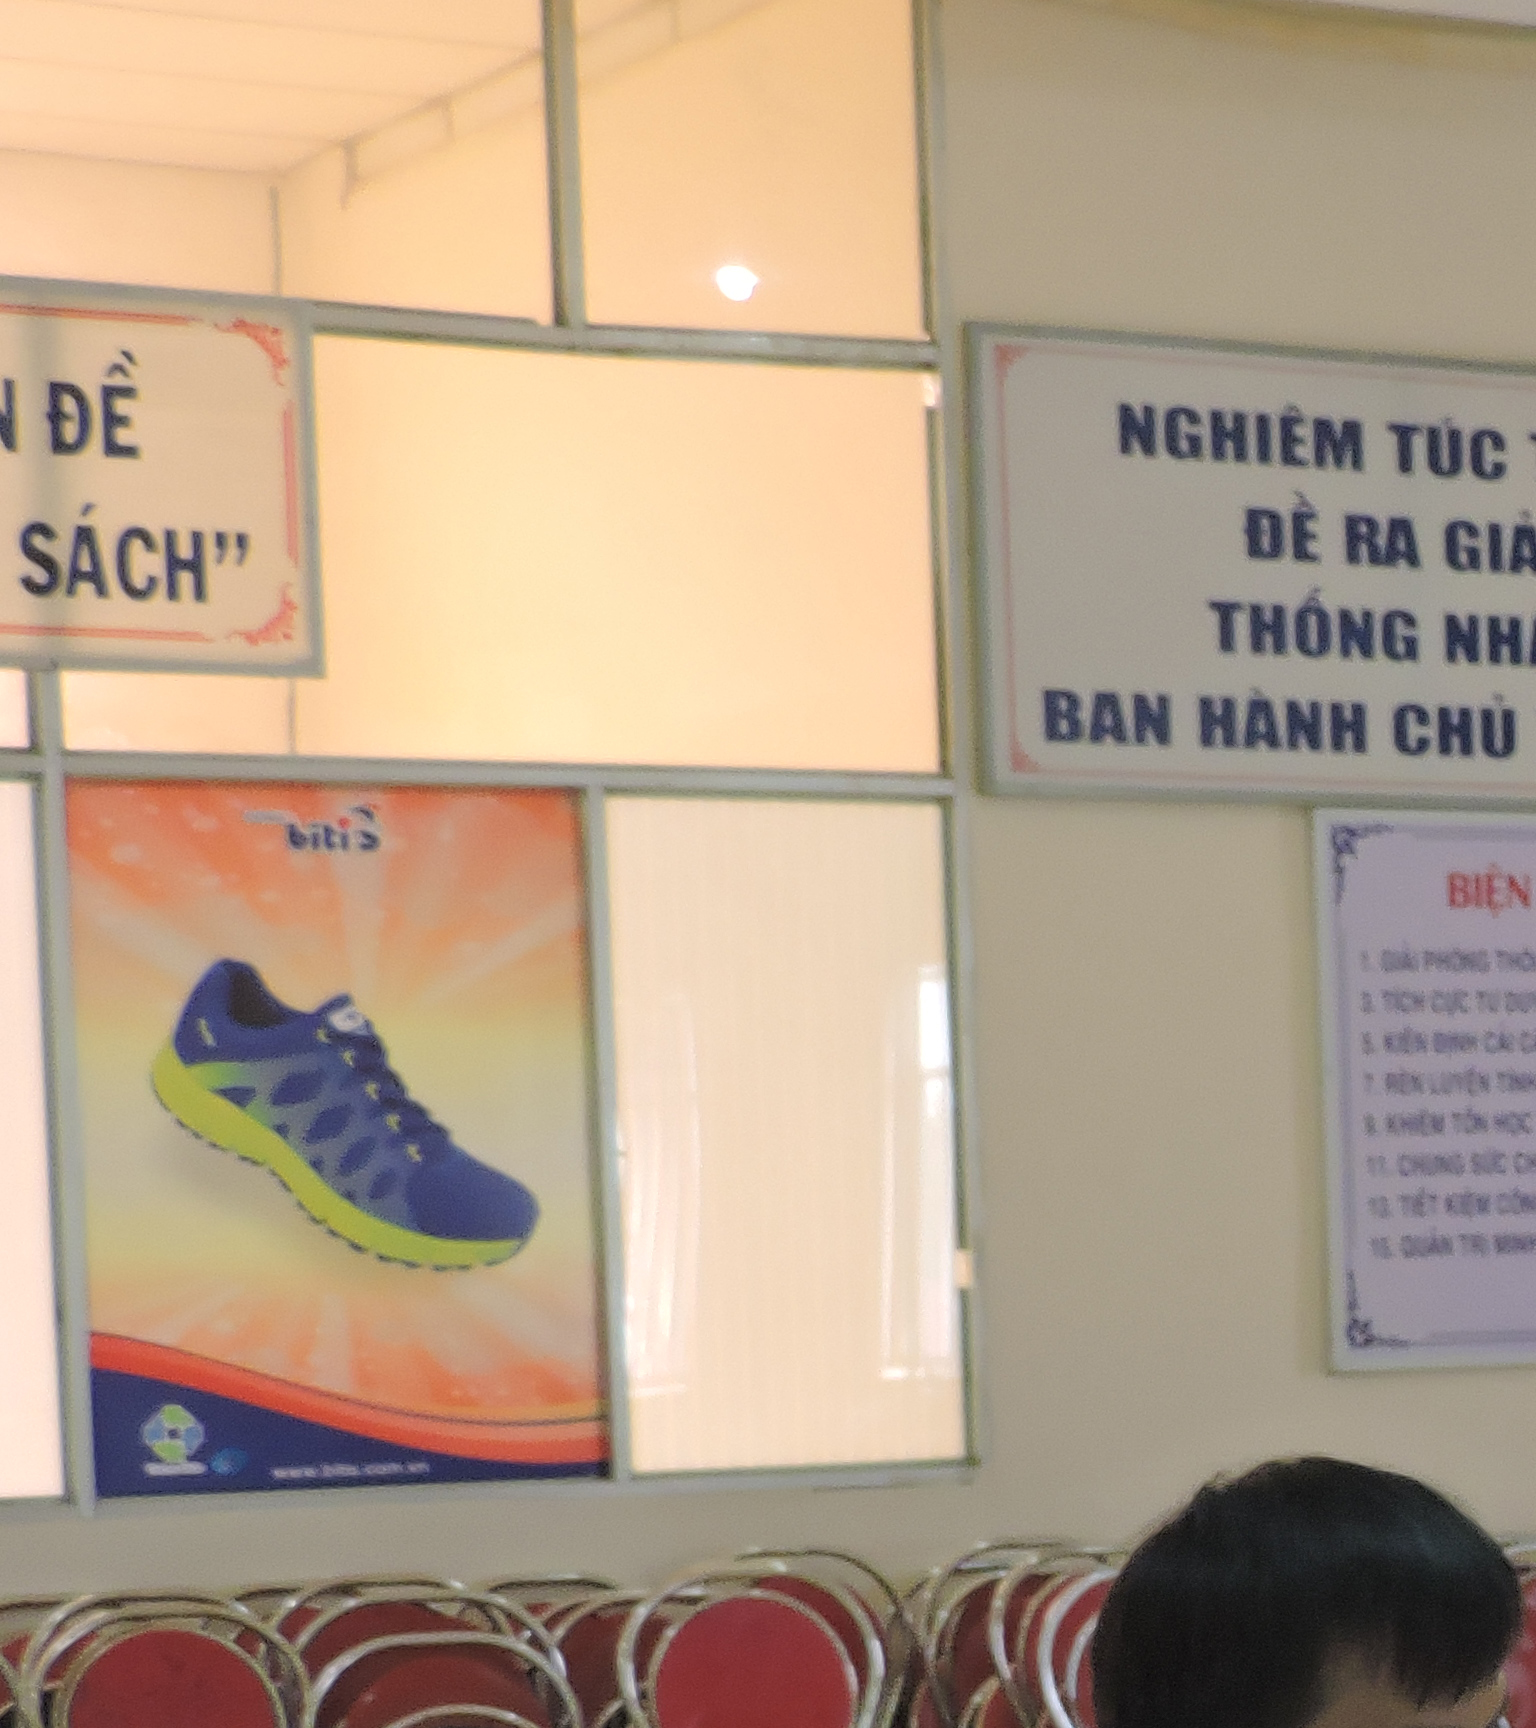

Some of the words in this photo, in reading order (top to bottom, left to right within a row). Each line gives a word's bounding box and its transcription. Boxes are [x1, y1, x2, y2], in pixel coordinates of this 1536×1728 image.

[47, 349, 141, 461] ĐỀ
[1117, 402, 1365, 472] NGHIÊM
[1387, 417, 1507, 481] TÚC
[1244, 490, 1320, 564] ĐỀ
[1344, 512, 1421, 570] RA
[1208, 585, 1420, 664] THỐNG
[1041, 687, 1172, 747] BAN
[1199, 685, 1369, 754] HÀNH
[1392, 692, 1517, 760] CHỦ
[1446, 861, 1532, 919] BIỆN
